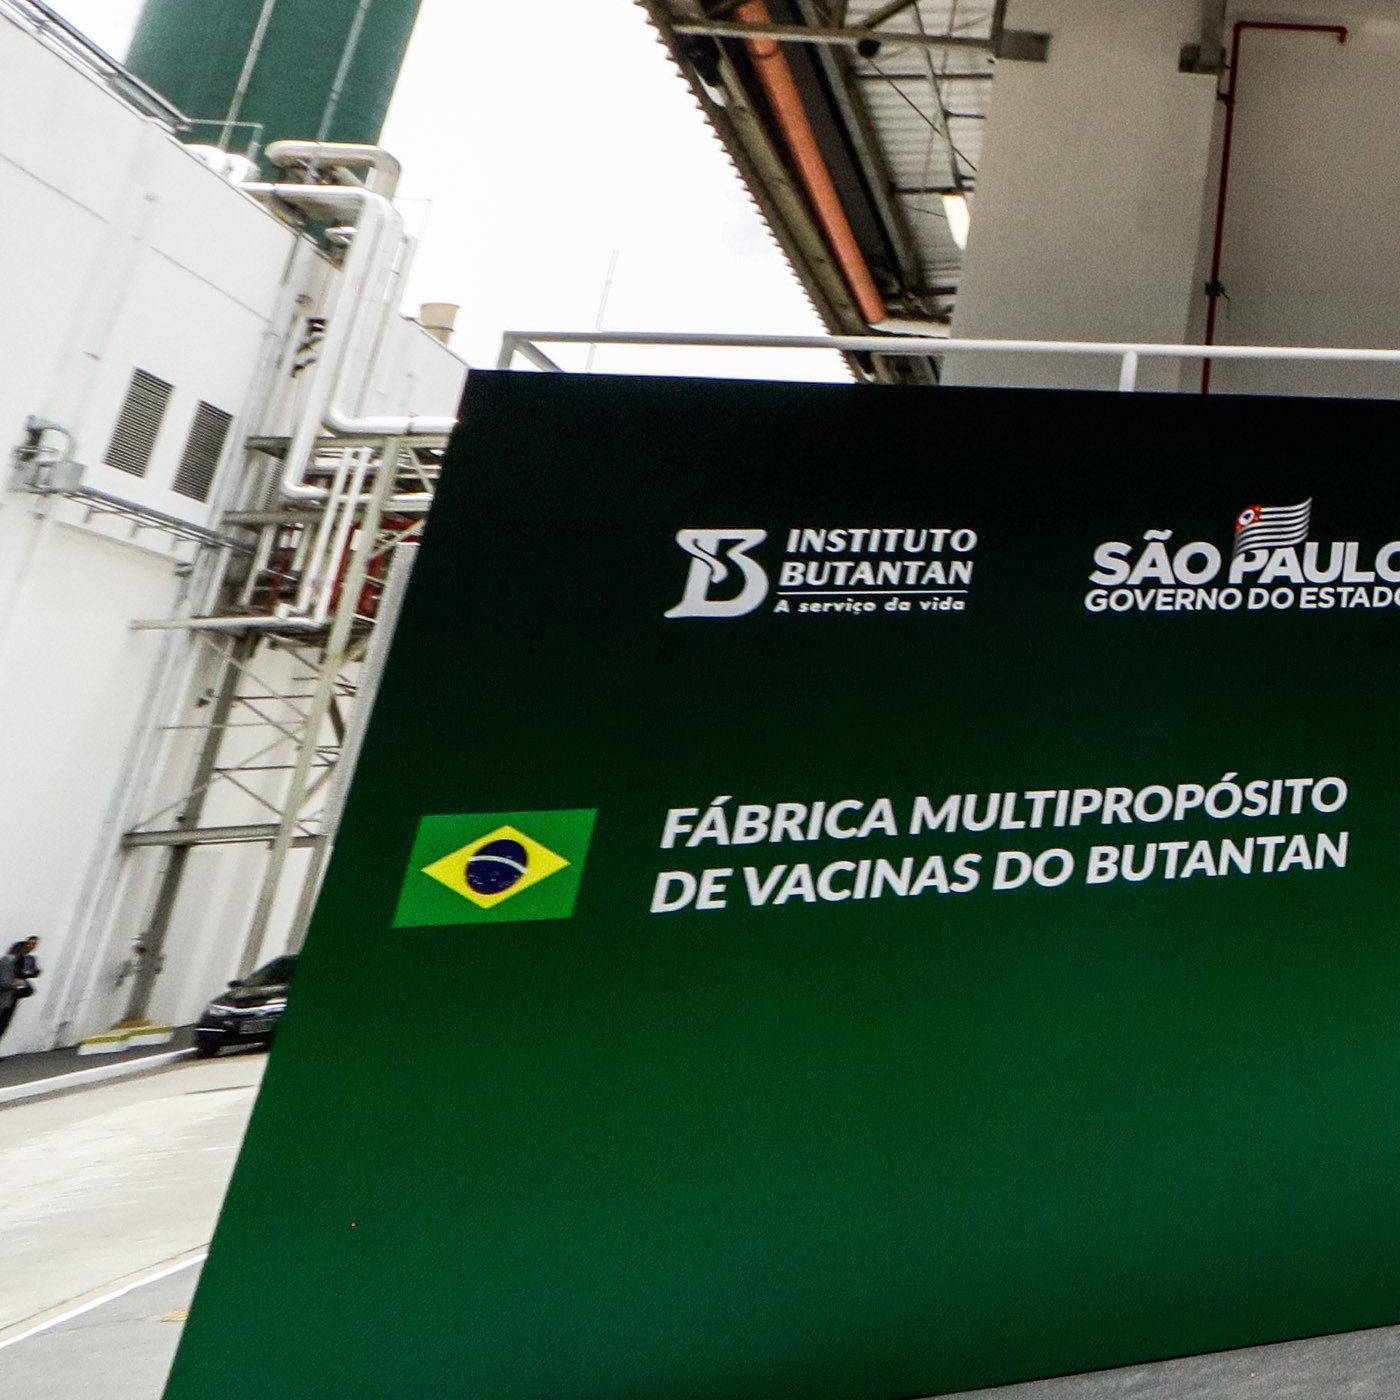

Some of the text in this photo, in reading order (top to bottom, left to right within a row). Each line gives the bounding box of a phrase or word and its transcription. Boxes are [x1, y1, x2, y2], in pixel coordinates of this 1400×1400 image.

[786, 528, 978, 553] INSTITUTO
[1088, 529, 1222, 586] SÃO
[779, 560, 974, 586] BUTANTAN
[773, 596, 966, 615] A serviço da vida
[1084, 587, 1243, 612] GOVERNO
[1247, 587, 1295, 610] DO
[660, 771, 1348, 849] FÁBRICA MULTIPROPÓSITO
[649, 831, 1349, 914] DE VACINAS DO BUTANTAN
